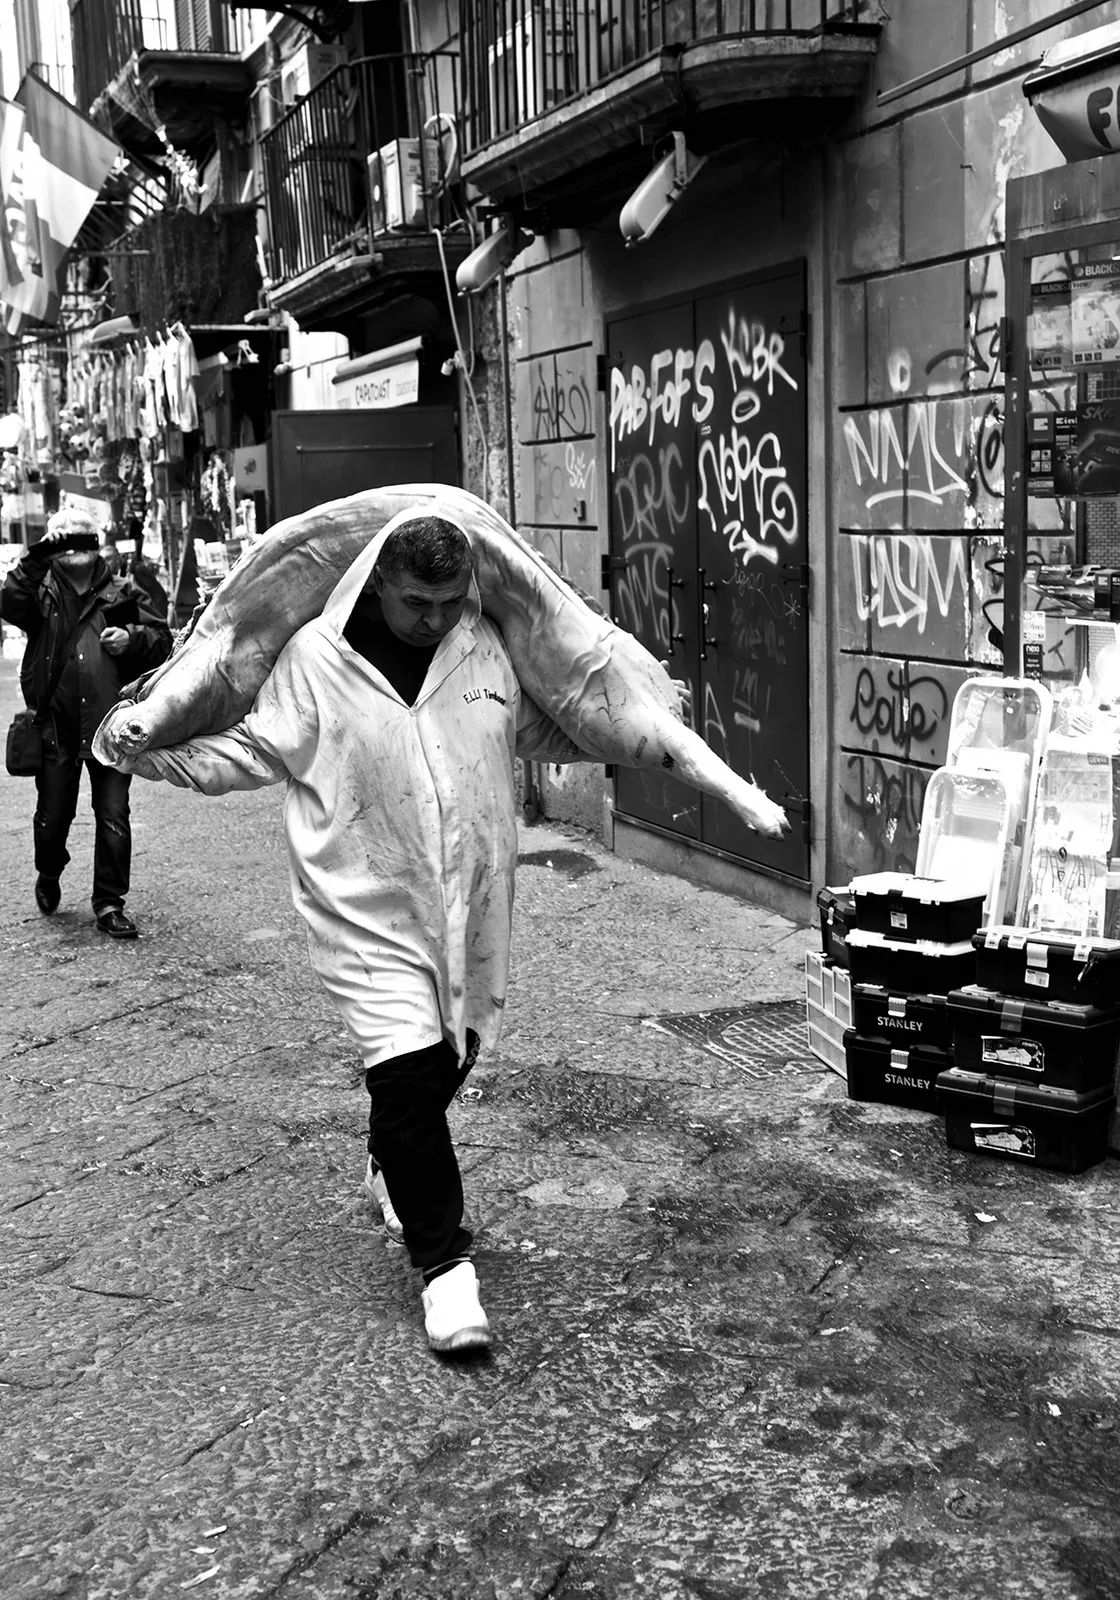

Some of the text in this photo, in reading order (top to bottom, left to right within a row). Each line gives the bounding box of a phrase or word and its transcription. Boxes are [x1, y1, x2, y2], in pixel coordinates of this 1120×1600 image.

[1086, 85, 1120, 149] F
[877, 1016, 923, 1032] STANLEY
[885, 1073, 931, 1090] STANLEY
